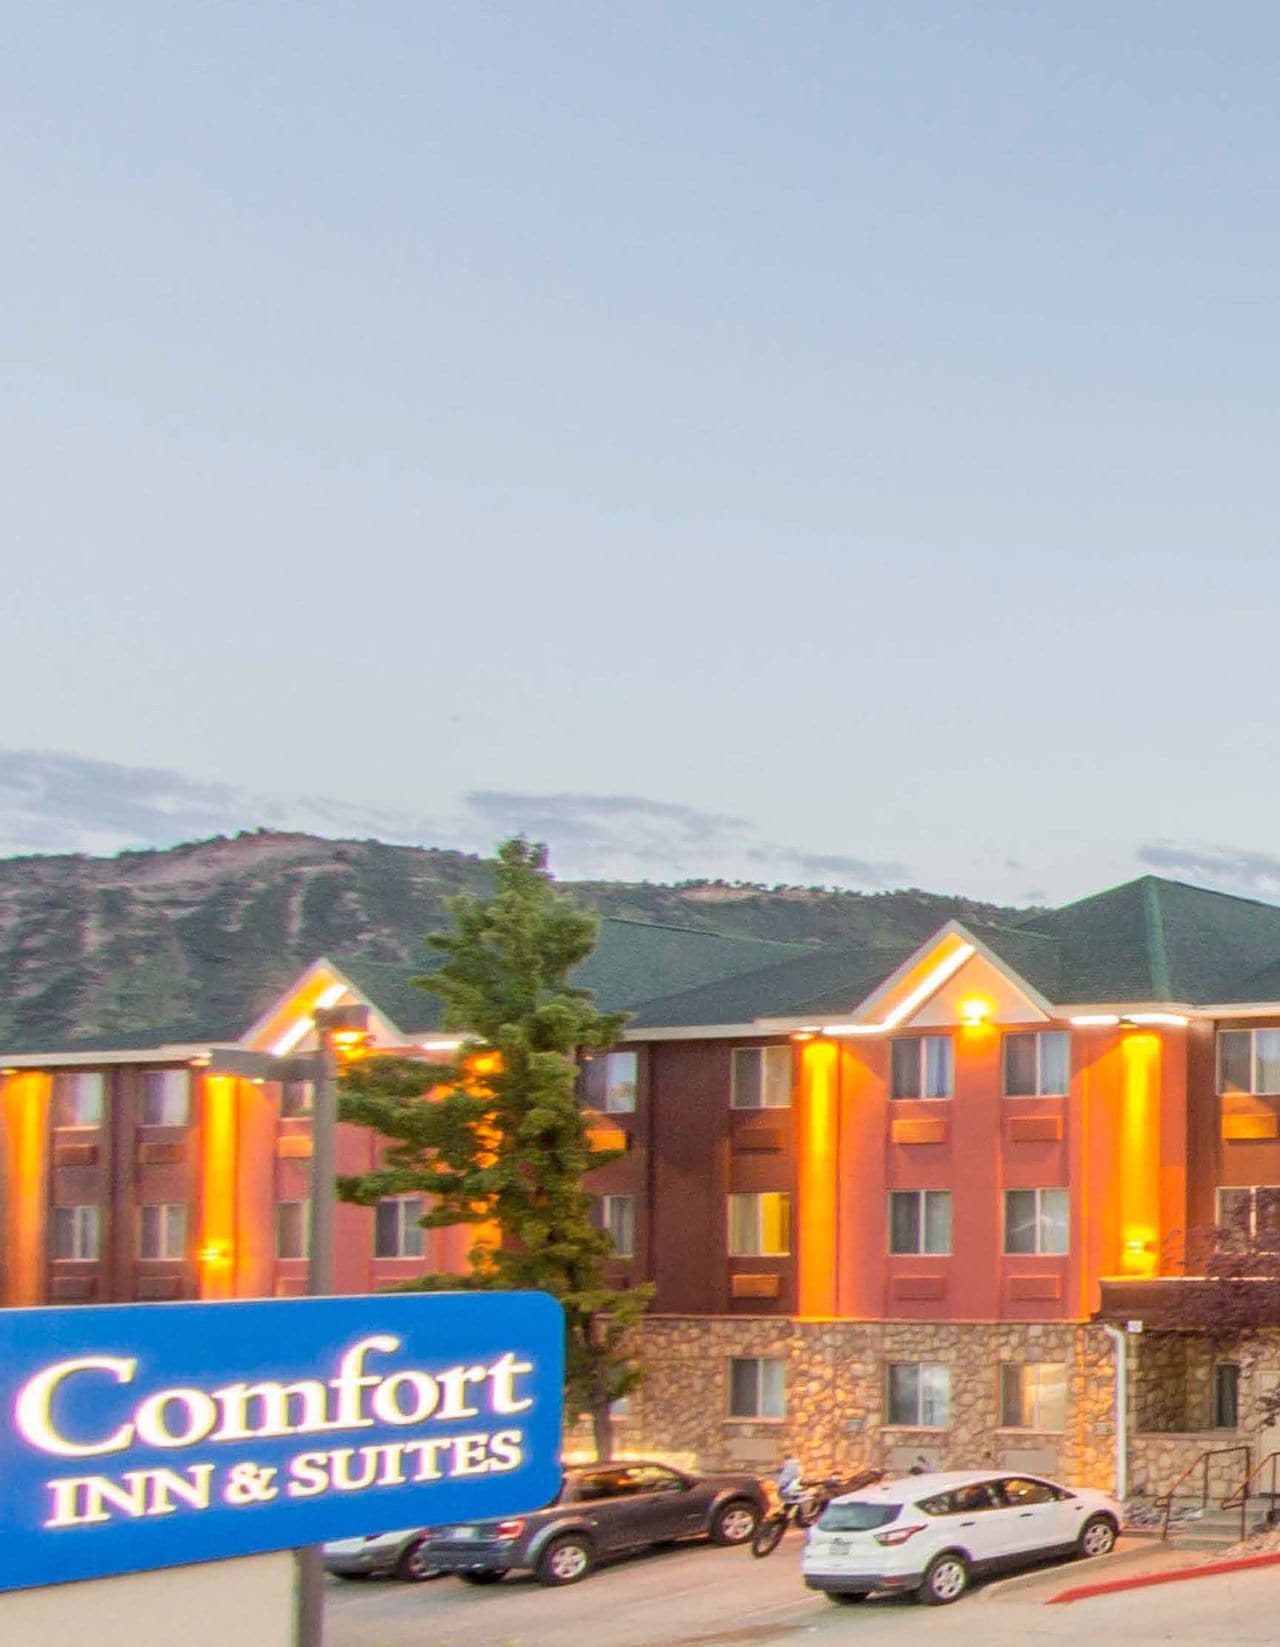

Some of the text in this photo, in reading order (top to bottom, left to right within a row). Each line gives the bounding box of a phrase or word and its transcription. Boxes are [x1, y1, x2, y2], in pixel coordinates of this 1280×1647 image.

[15, 1335, 534, 1458] Comfort
[44, 1430, 524, 1528] INN & SUITES
